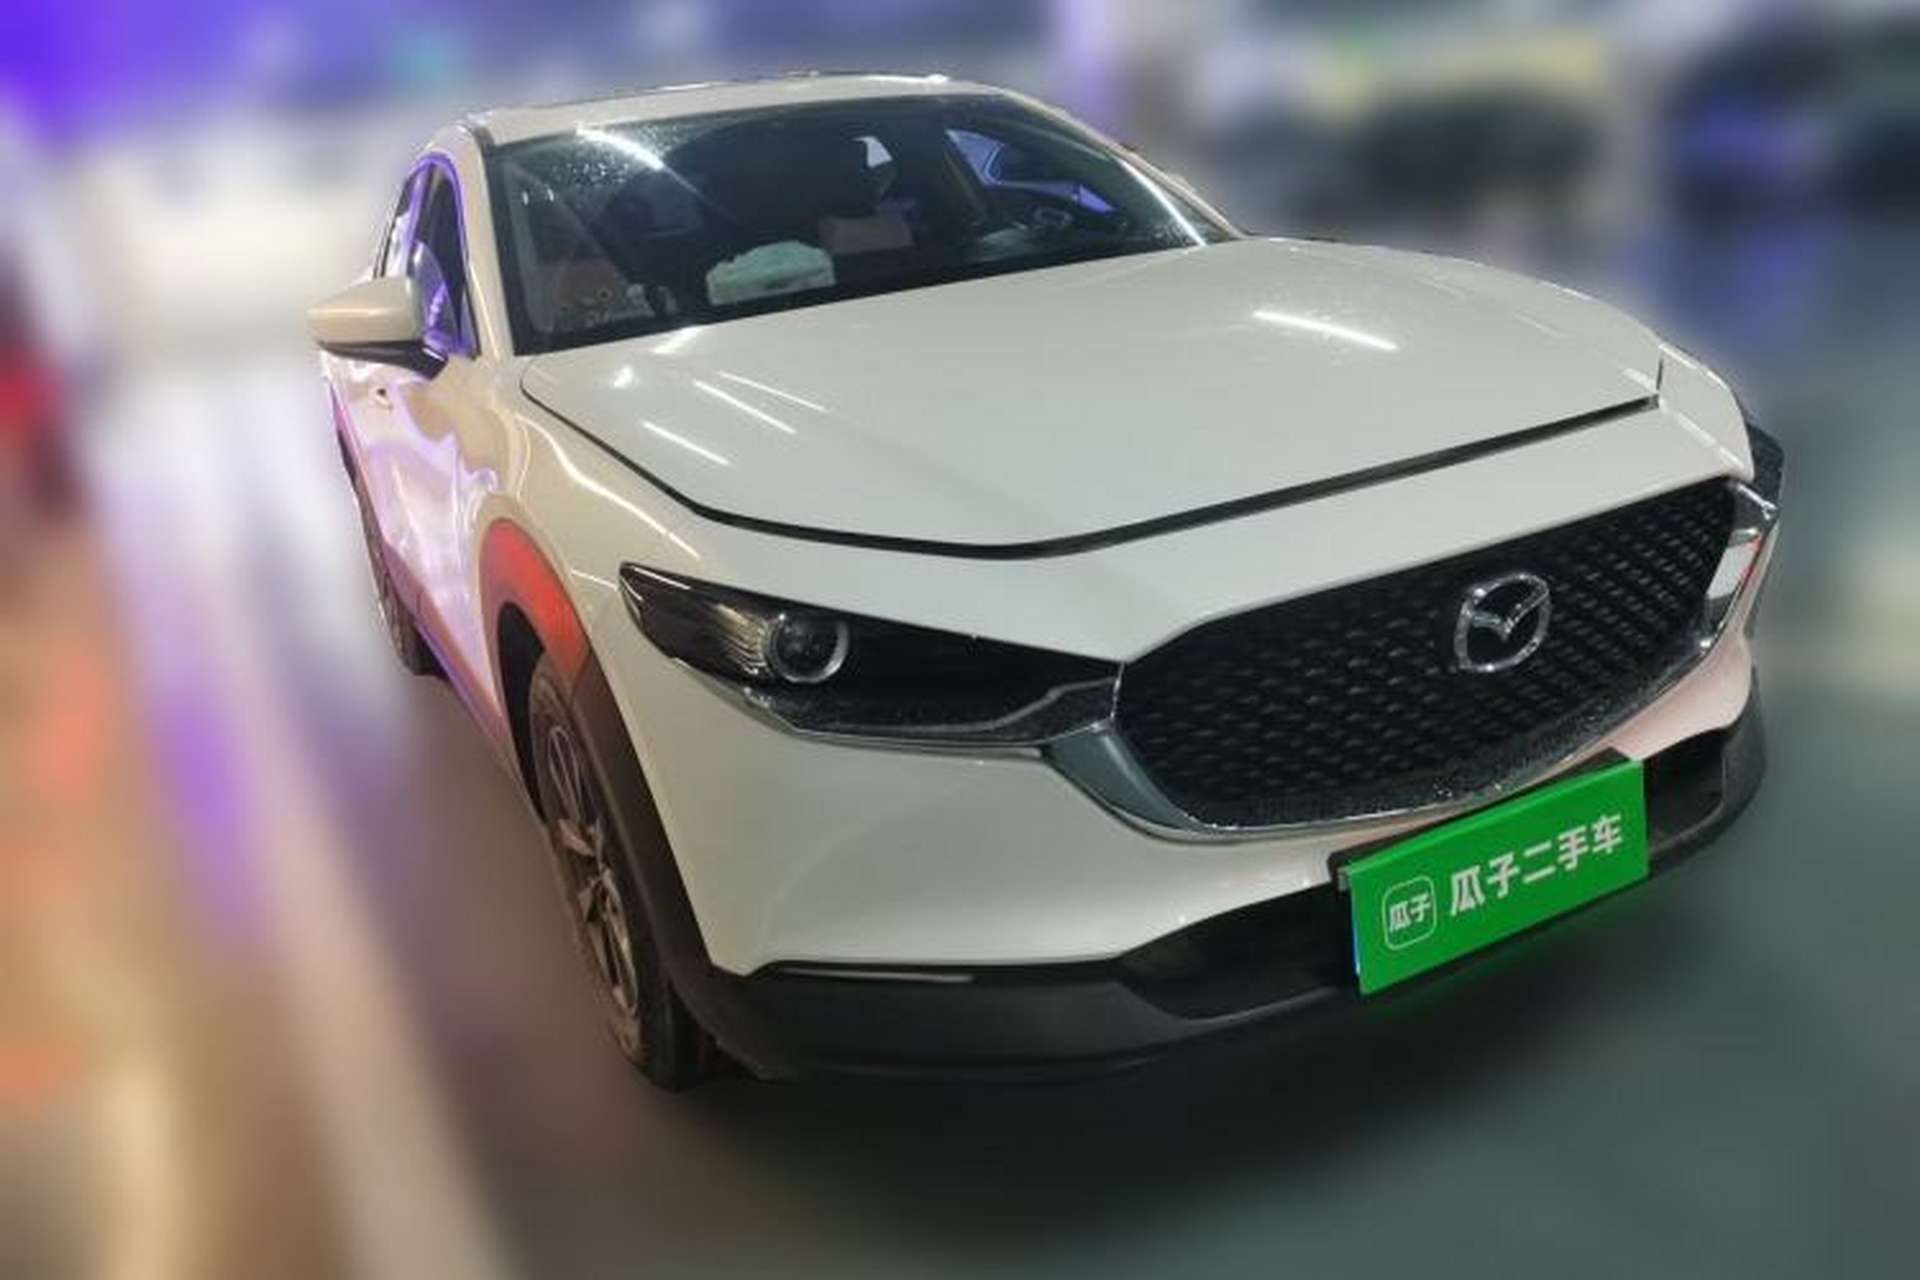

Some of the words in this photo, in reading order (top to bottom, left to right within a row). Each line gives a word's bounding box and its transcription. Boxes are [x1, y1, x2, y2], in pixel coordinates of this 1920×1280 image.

[1451, 813, 1622, 916] 瓜子二手车
[1389, 893, 1430, 932] 瓜子
